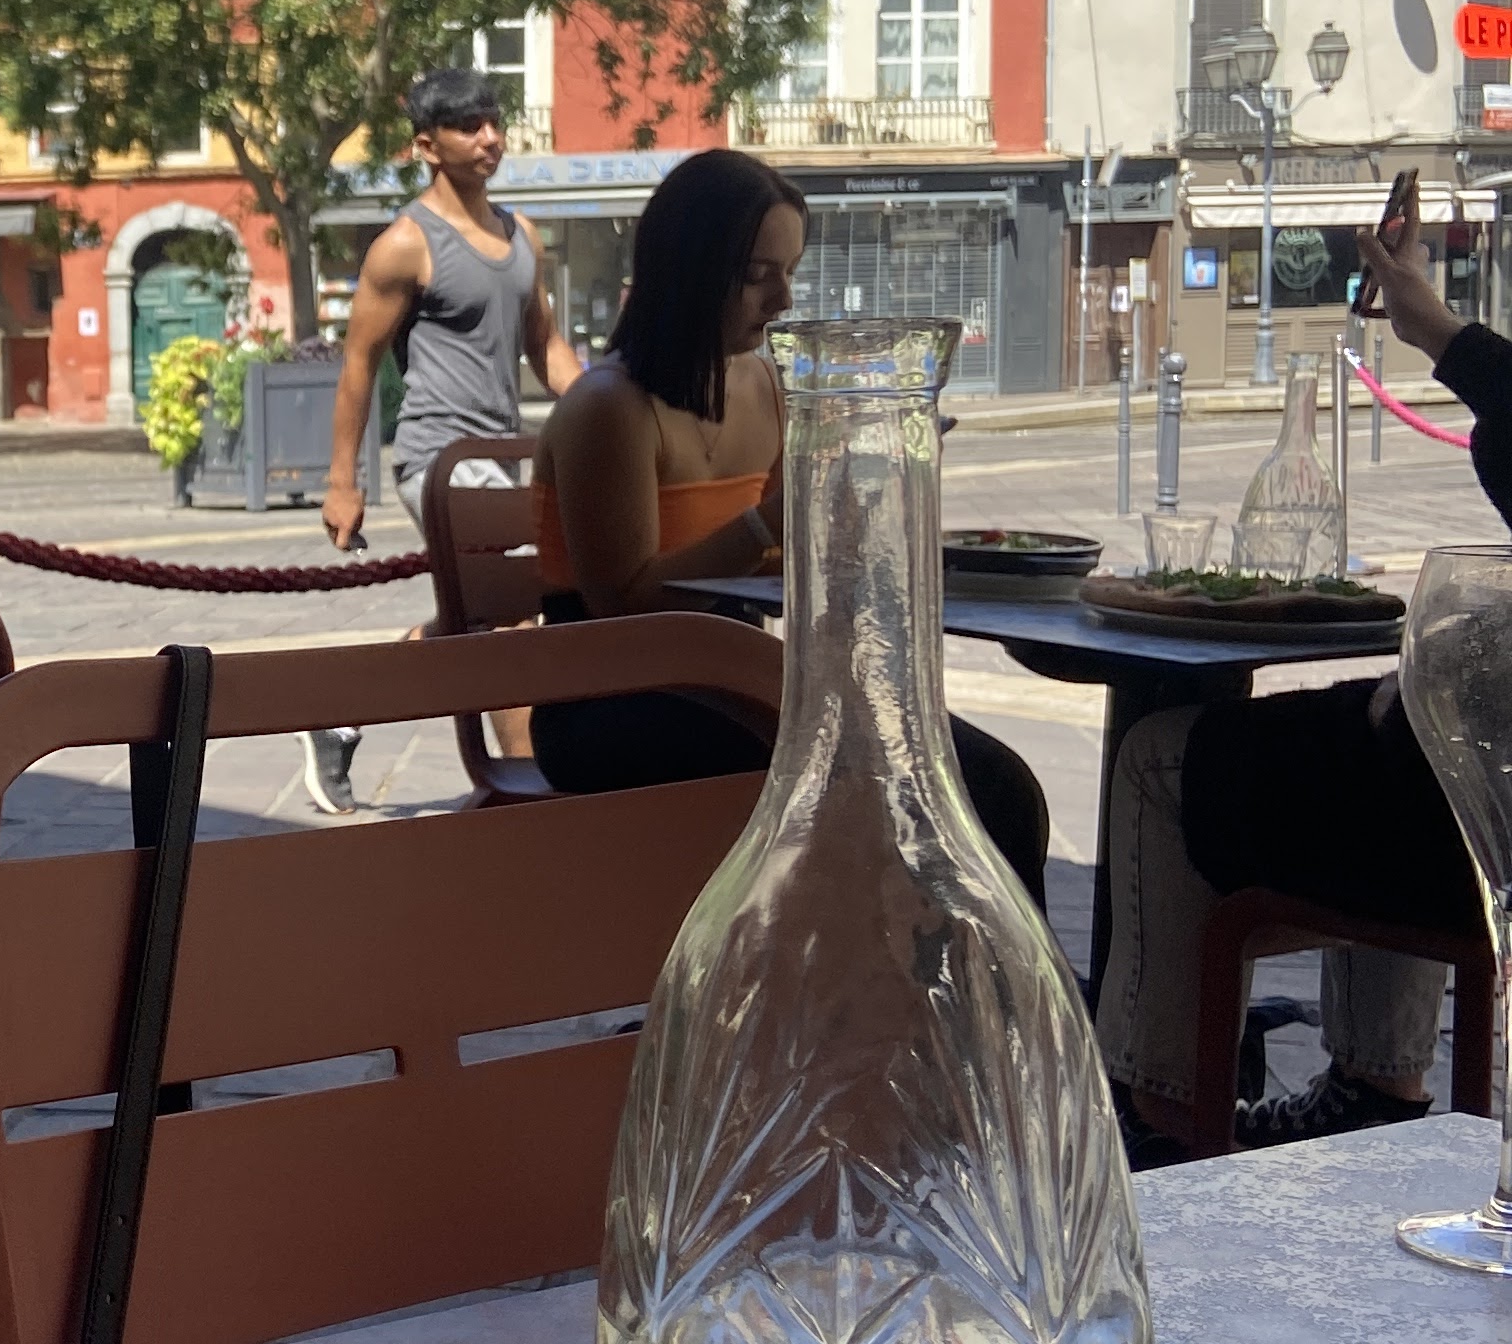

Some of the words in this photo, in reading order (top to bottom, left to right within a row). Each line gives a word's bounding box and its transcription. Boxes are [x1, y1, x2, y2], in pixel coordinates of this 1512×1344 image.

[1464, 14, 1488, 47] LE
[507, 158, 554, 184] LA
[568, 153, 681, 182] DERIV
